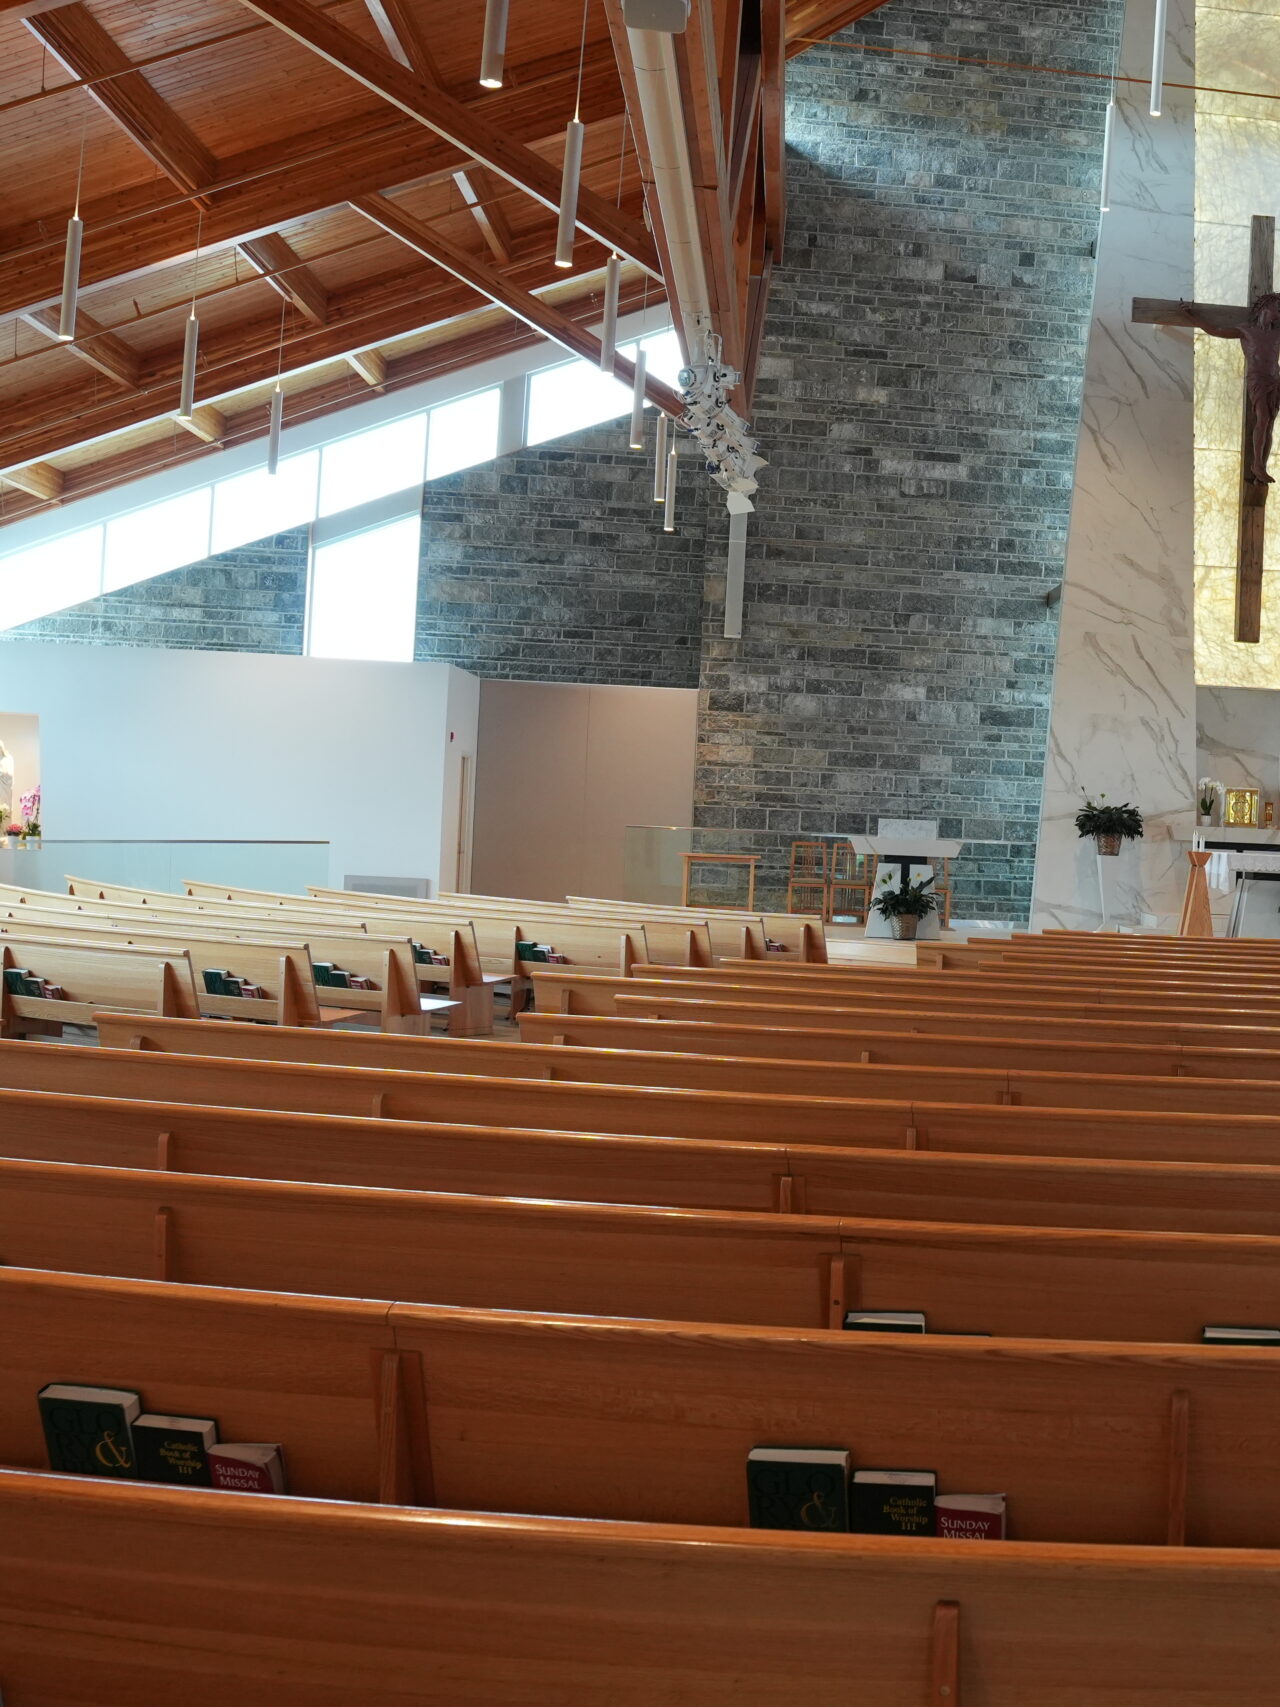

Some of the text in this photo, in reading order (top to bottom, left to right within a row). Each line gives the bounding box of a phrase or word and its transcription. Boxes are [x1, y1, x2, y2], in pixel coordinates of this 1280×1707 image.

[95, 1430, 131, 1469] &
[215, 1464, 260, 1479] SUNDAY
[219, 1476, 261, 1490] MISSAL
[883, 1503, 906, 1513] Book
[889, 1496, 927, 1507] Catholic
[891, 1513, 928, 1525] Worship
[940, 1516, 991, 1531] SUNDAY
